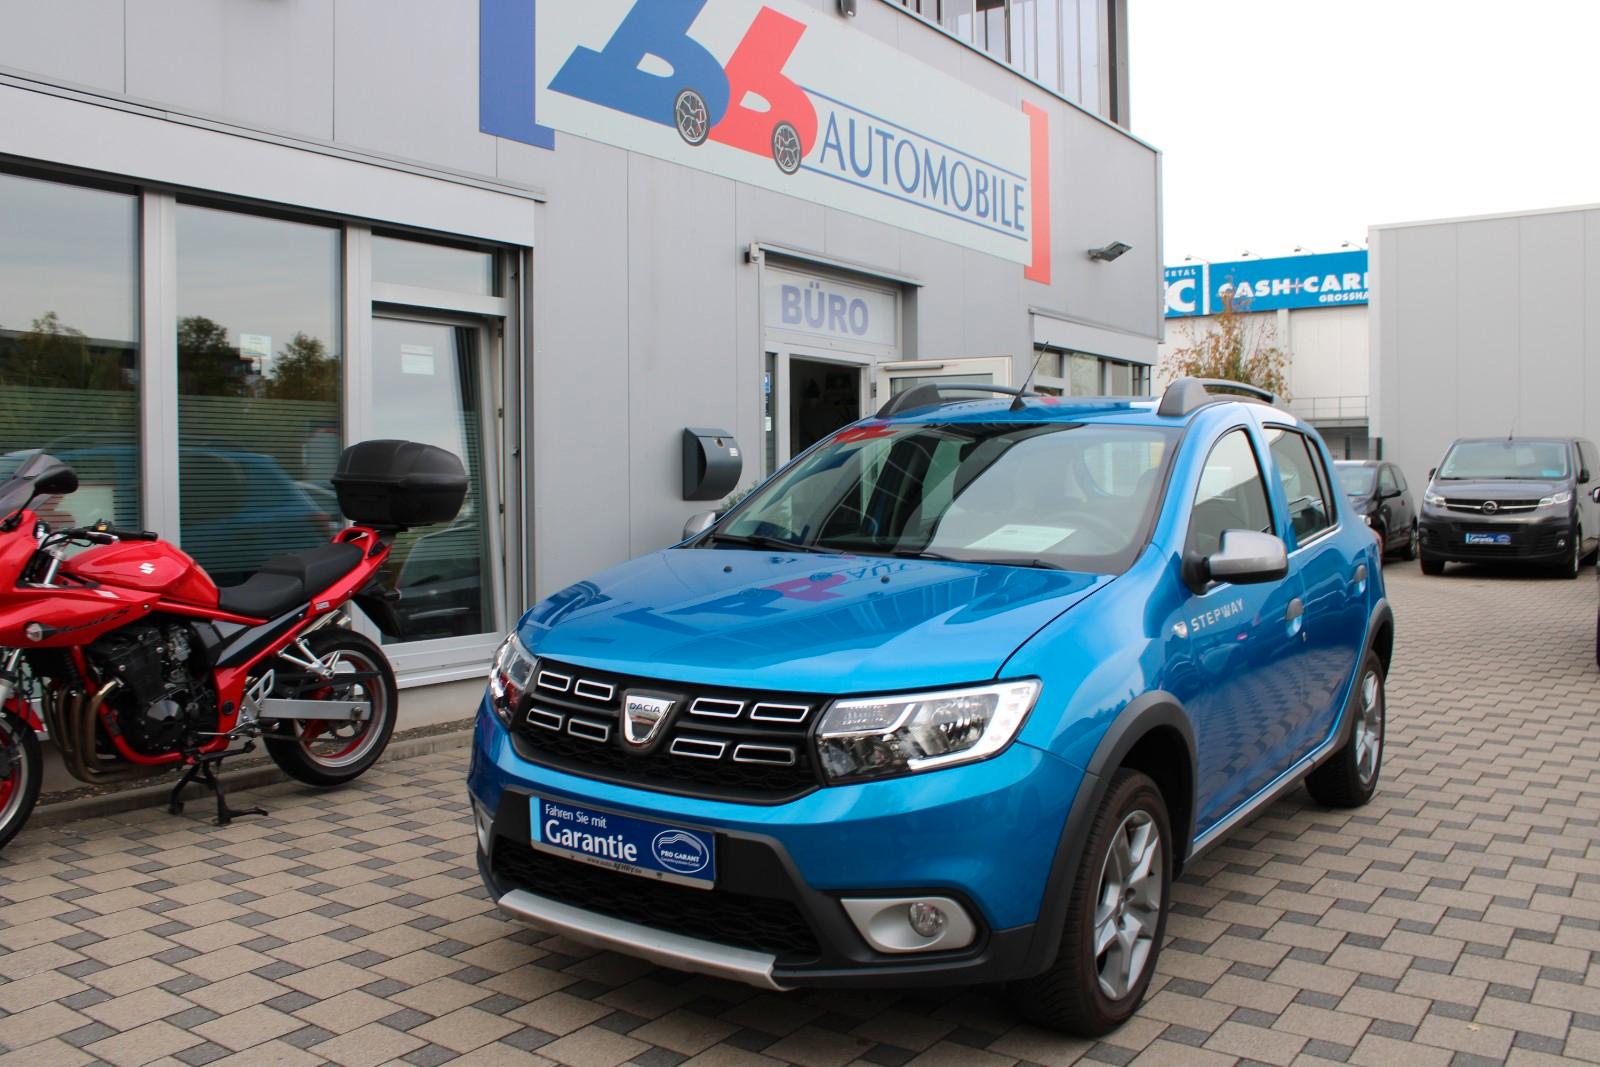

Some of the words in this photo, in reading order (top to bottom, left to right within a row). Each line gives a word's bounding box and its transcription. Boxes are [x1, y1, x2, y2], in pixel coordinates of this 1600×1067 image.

[819, 110, 1026, 232] AUTOMOBILE
[1217, 272, 1369, 299] CASH+CAR
[781, 281, 869, 336] BÜRO
[1190, 598, 1244, 632] STEPWAY
[629, 702, 661, 713] DACIA
[545, 803, 574, 821] Fahren
[575, 810, 589, 825] Sie
[591, 815, 607, 830] mit
[545, 818, 638, 862] Garantie
[660, 849, 674, 859] PRO
[674, 851, 701, 864] GARANT
